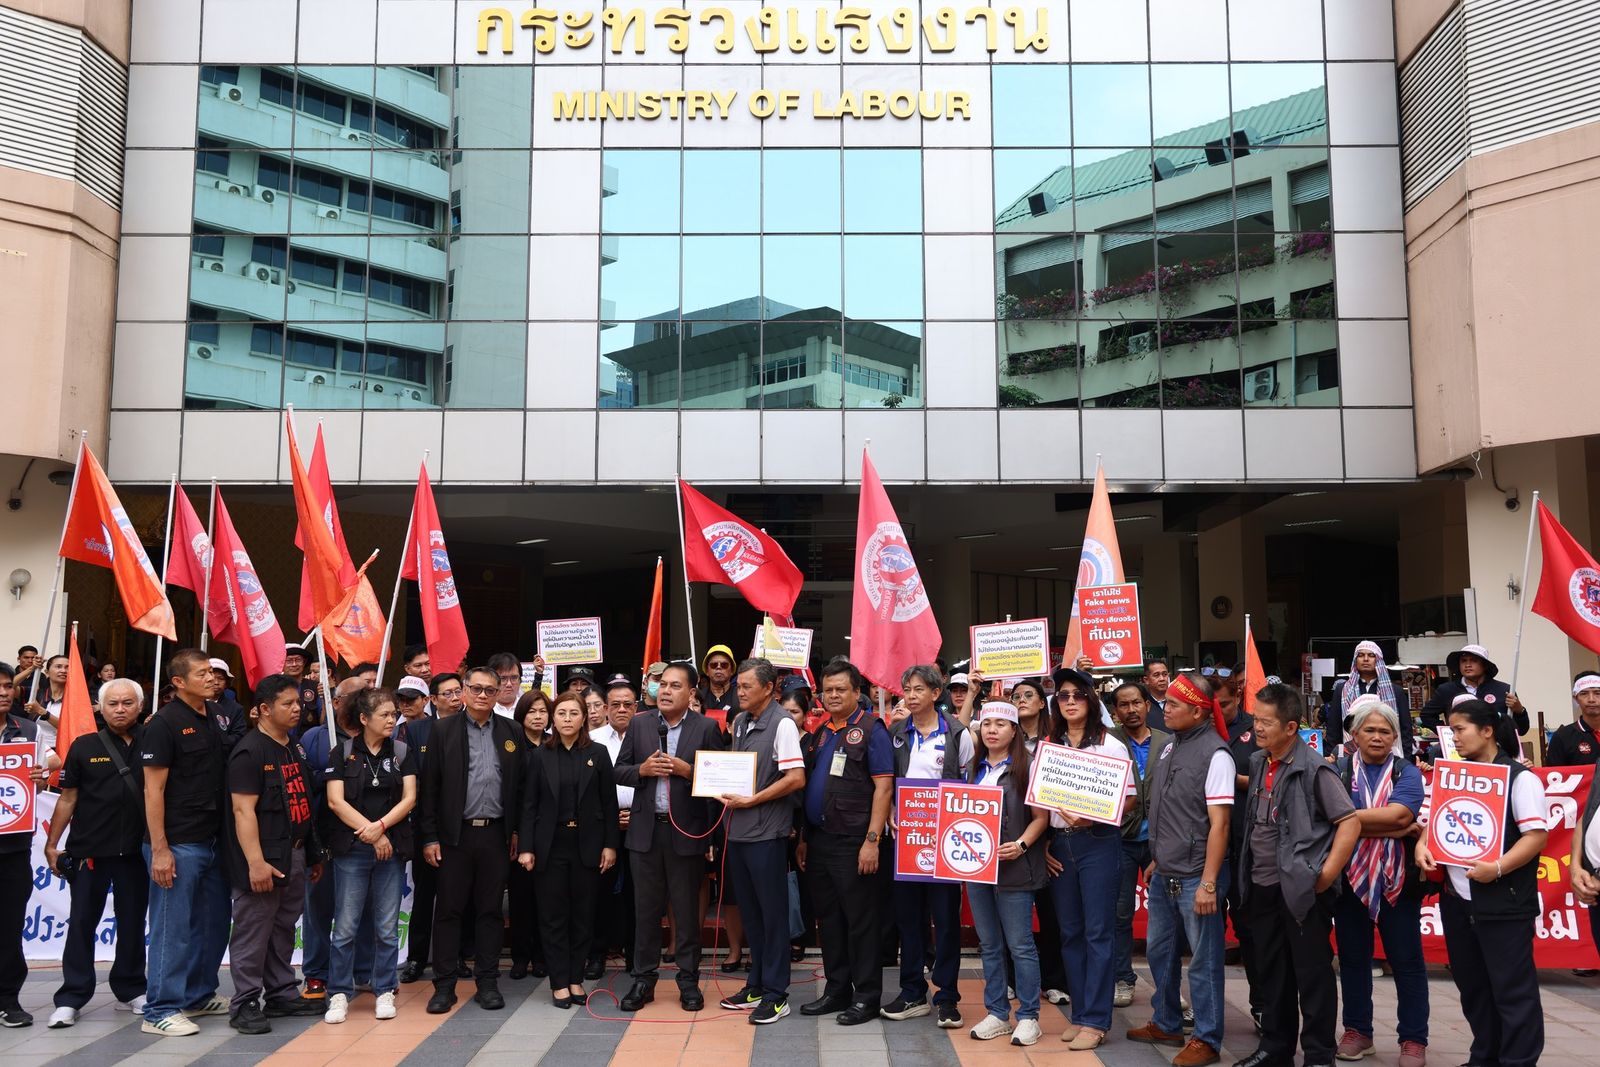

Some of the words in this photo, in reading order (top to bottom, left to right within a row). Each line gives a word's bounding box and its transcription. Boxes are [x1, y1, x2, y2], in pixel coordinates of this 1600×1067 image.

[476, 7, 1051, 54] กระทรวงแรงงาน
[552, 91, 737, 121] MINISTRY
[748, 91, 802, 121] OF
[812, 91, 972, 121] LABOUR
[1092, 587, 1121, 597] เราไม่ใช่
[1107, 597, 1131, 605] news
[1089, 625, 1131, 640] ที่ไม่เอา
[0, 753, 33, 770] เอา
[1044, 748, 1125, 770] การลดอัตราเงินสมทบ
[1047, 756, 1117, 778] ไม่ใช่ผลงานรัฐบาล
[1041, 766, 1119, 788] แต่เป็นความหน้าด้าน
[1042, 773, 1114, 797] ที่แก้ไขปัญหาไม่เป็น
[1439, 766, 1505, 796] ไม่เอา
[914, 790, 938, 798] เราไม่ใ
[905, 799, 926, 808] Fake
[944, 792, 999, 816] ไม่เอา
[1445, 809, 1483, 828] สูตร
[906, 828, 930, 846] ที่ไม่
[951, 830, 983, 847] สูตร
[1445, 831, 1487, 848] CARE
[951, 850, 986, 862] CARE
